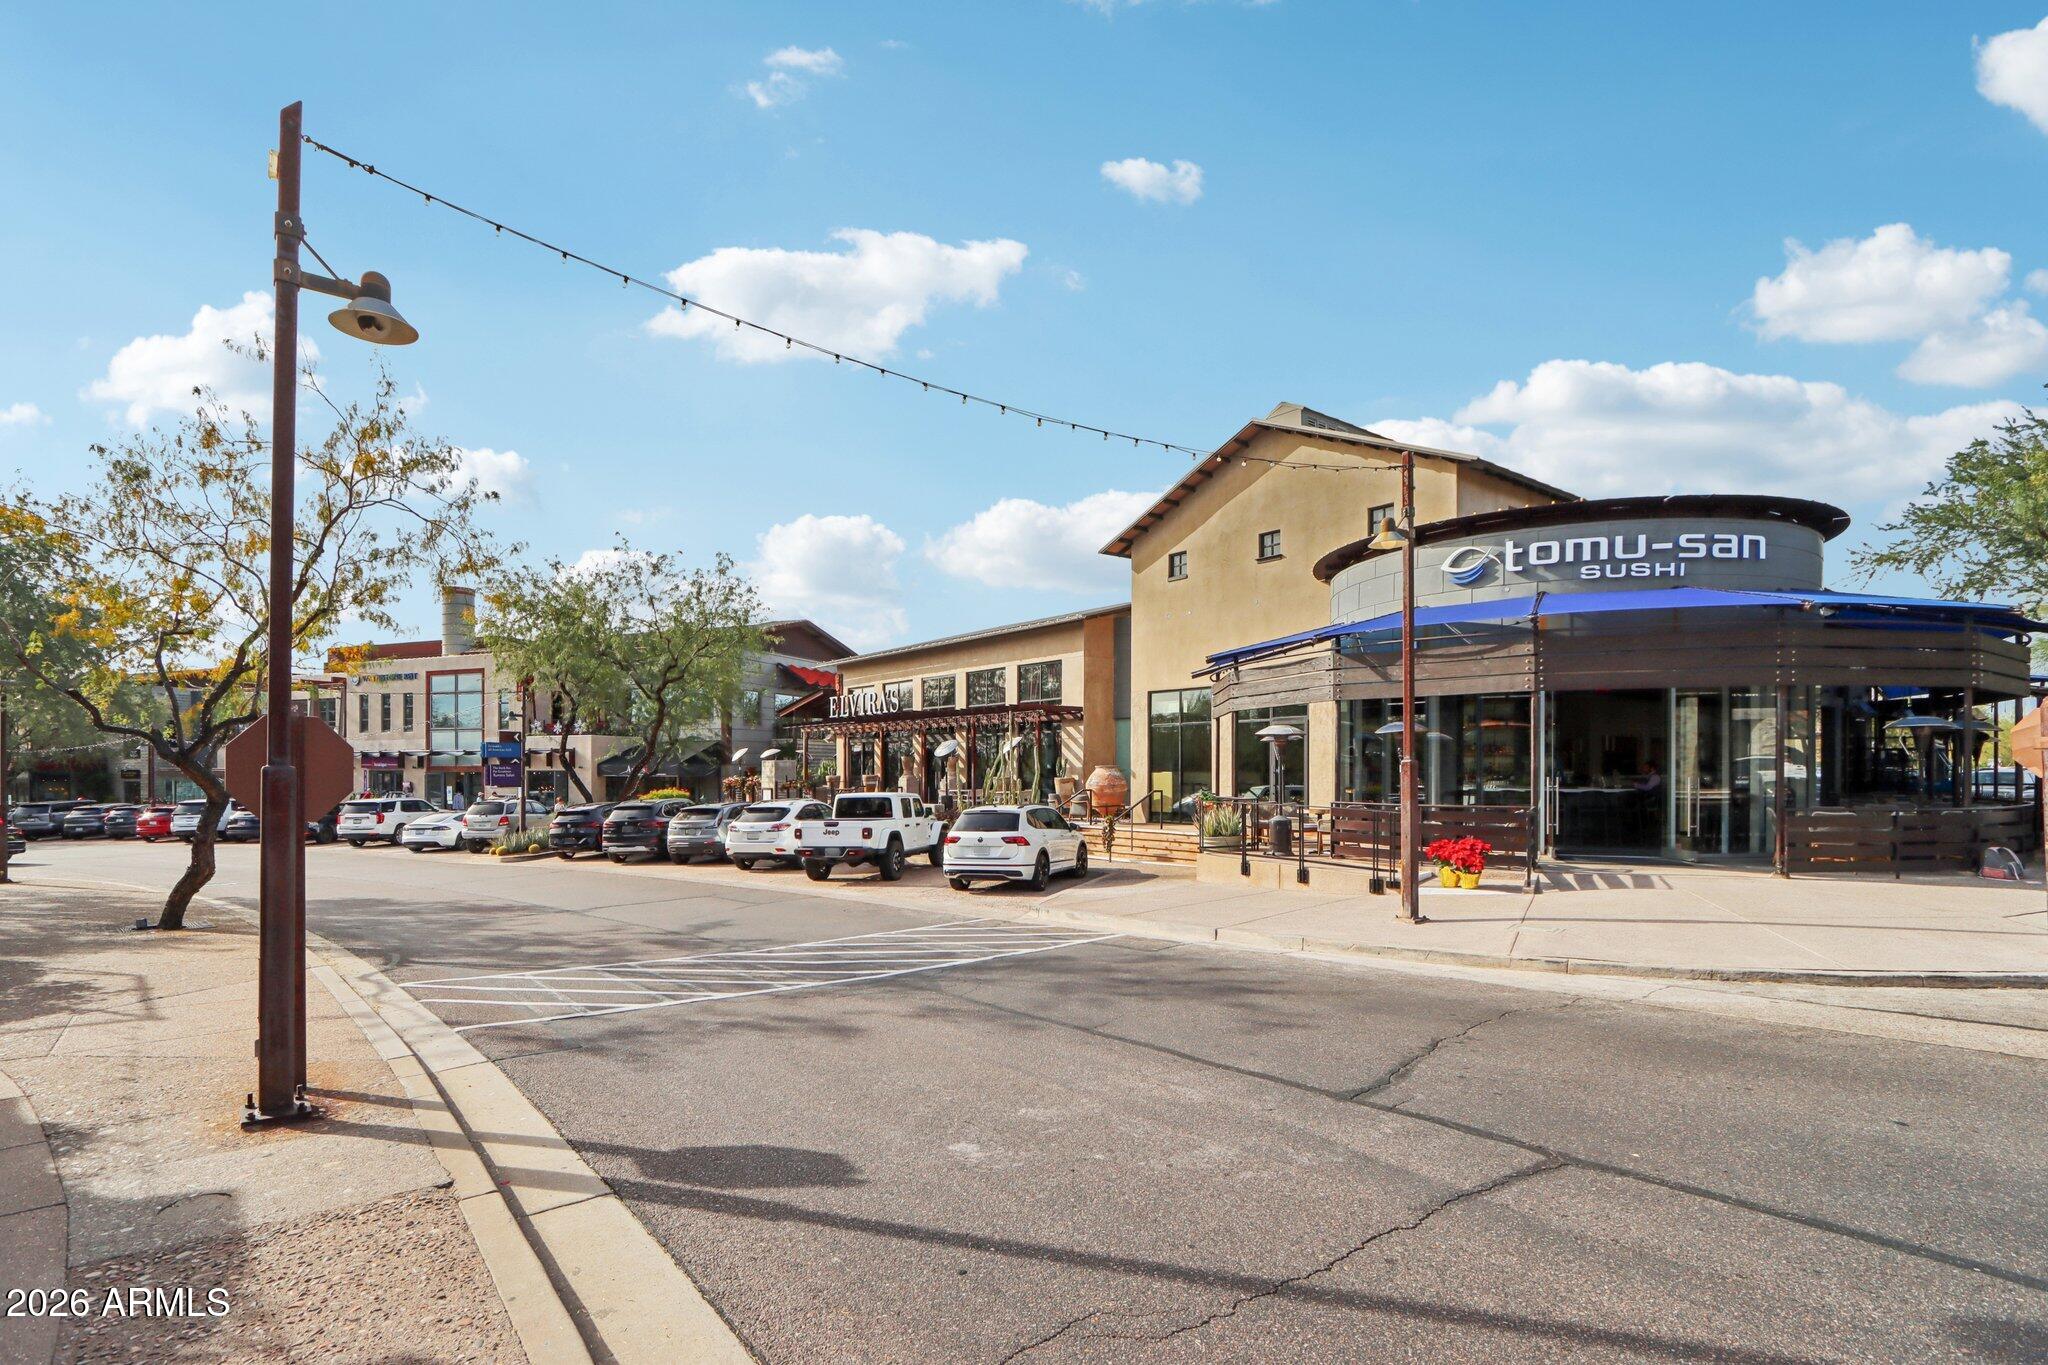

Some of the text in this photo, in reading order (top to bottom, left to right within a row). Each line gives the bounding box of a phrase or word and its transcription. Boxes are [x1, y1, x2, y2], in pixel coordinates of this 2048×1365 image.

[1504, 533, 1767, 572] tomu-san
[1580, 562, 1686, 580] SUSHI
[829, 689, 900, 718] ELVIRA'S
